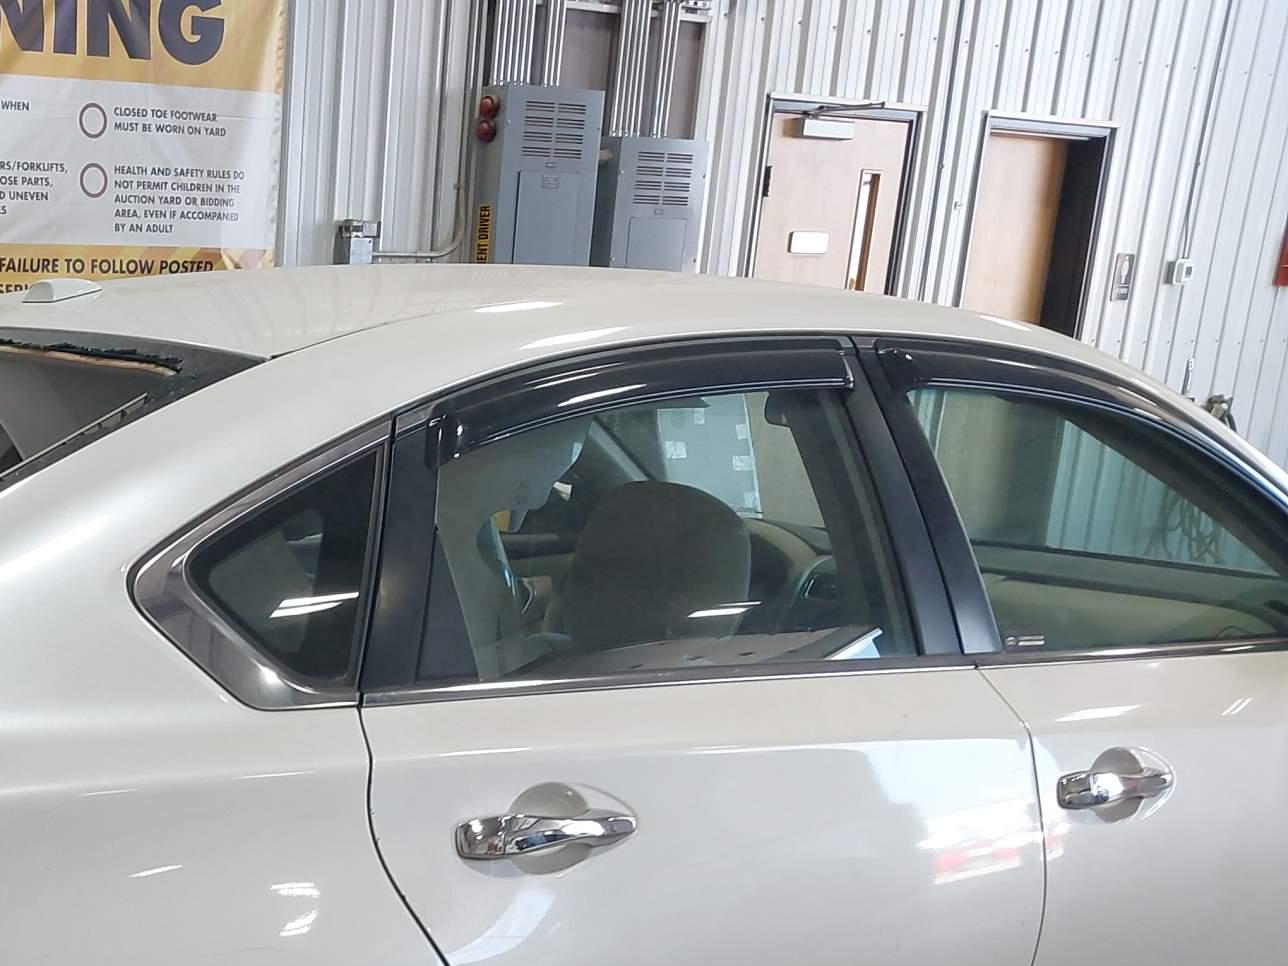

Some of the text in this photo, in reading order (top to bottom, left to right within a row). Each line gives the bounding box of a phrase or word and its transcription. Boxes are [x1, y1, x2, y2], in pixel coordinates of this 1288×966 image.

[1, 100, 30, 111] WHEN
[114, 107, 217, 122] CLOSED TOE FOOTWEAR
[114, 122, 226, 136] MUST BE WORN ON YARD
[114, 165, 245, 180] HEALTH AND SAFETY RULES DO
[21, 176, 53, 188] PARTS,
[114, 180, 240, 193] NOT PERMIT CHILDREN IN THE
[9, 191, 48, 201] UNEVEN
[114, 194, 234, 207] AUCTION YARD OR BIDDING
[114, 209, 239, 221] AREA, EVEN IF ACCOMPANIED
[114, 223, 173, 233] BY AN ADULT
[478, 206, 490, 240] DRIVER
[64, 258, 85, 274] TO
[90, 258, 155, 274] FOLLOW
[159, 260, 213, 274] POSTED
